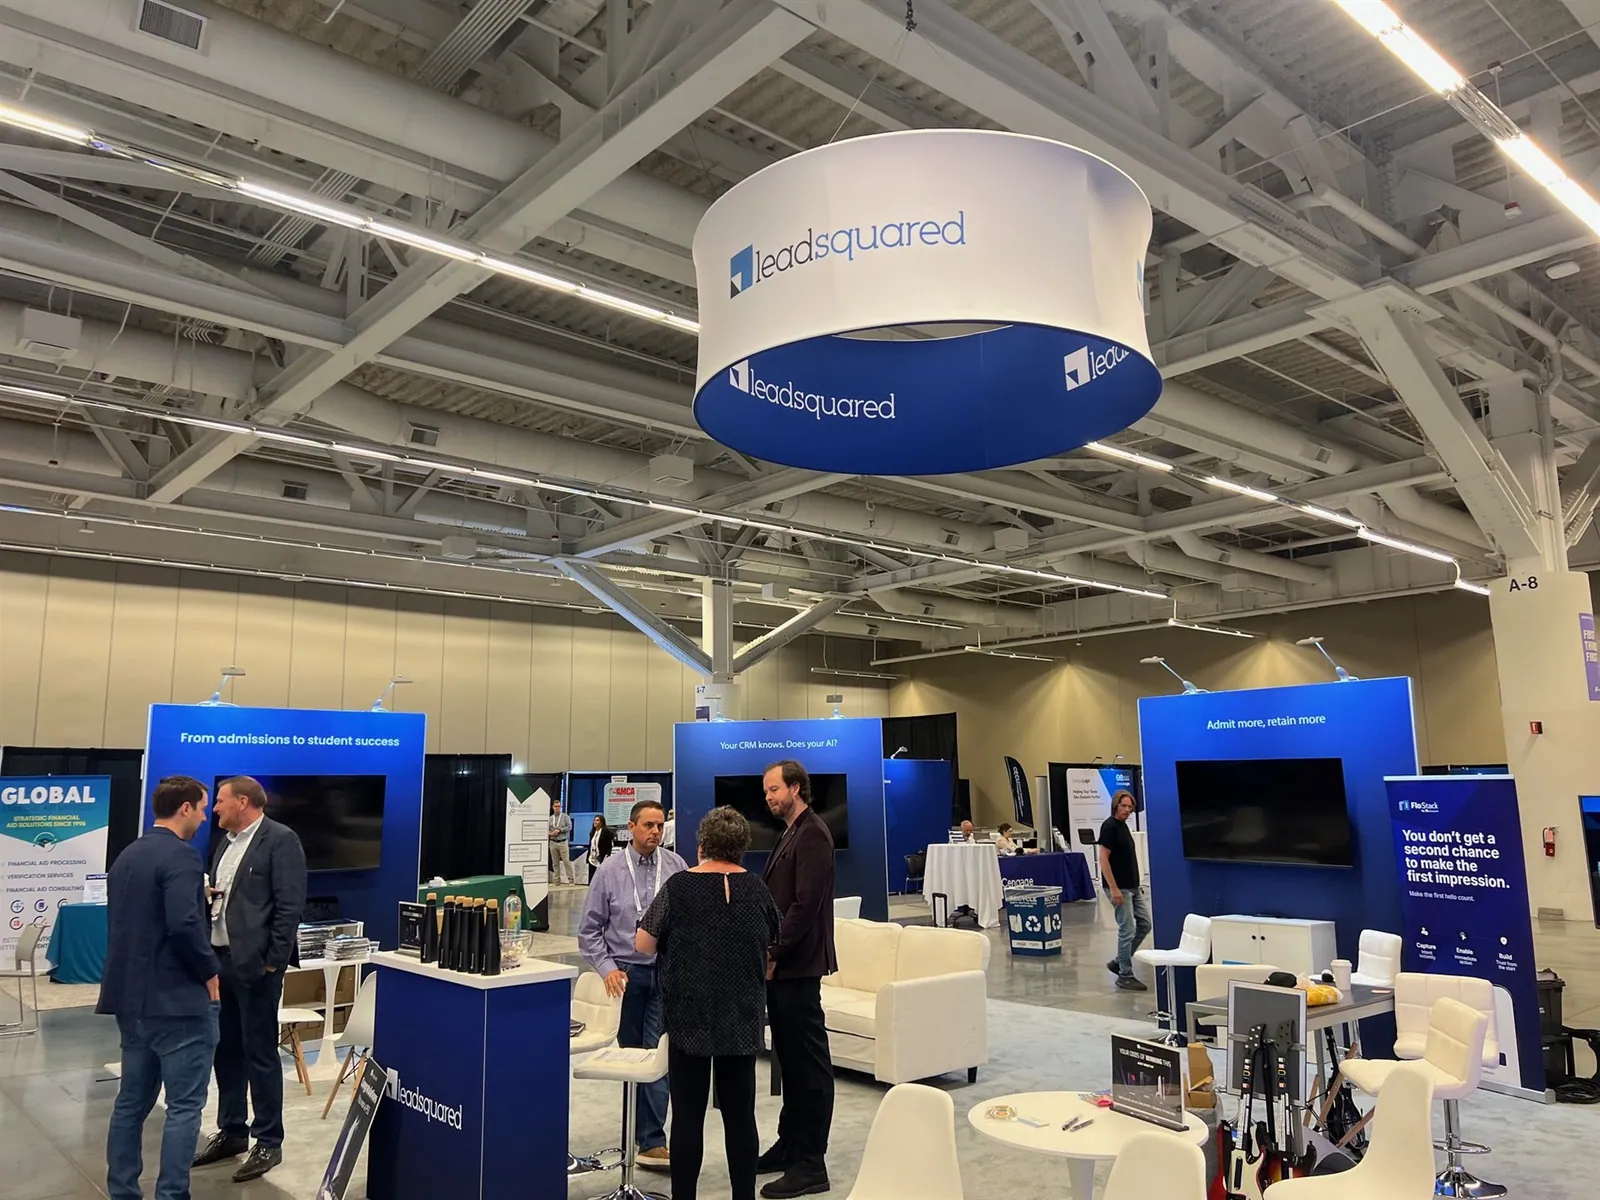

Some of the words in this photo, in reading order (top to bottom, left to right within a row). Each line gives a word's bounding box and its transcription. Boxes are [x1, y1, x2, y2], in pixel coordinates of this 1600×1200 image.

[756, 210, 966, 284] leadsquared
[750, 368, 896, 420] leadsquared
[1509, 576, 1538, 592] A-8
[1207, 719, 1236, 730] Admit
[1238, 719, 1266, 729] more,
[1267, 715, 1297, 727] retain
[1299, 715, 1326, 725] more
[180, 732, 215, 744] From
[218, 733, 290, 745] admissions
[293, 735, 305, 745] to
[307, 735, 353, 746] student
[355, 737, 400, 747] success
[720, 741, 737, 750] Your
[739, 741, 757, 749] CRM
[758, 740, 785, 749] knows.
[786, 739, 806, 748] Does
[807, 740, 824, 750] your
[825, 739, 838, 747] AI?
[1, 786, 96, 805] GLOBAL
[616, 787, 635, 796] AMCA
[1410, 801, 1438, 809] FloStack
[1402, 829, 1426, 842] You
[1428, 830, 1462, 843] don't
[1463, 832, 1485, 846] get
[1487, 835, 1496, 844] a
[1404, 844, 1449, 857] second
[1452, 845, 1500, 859] chance
[1405, 857, 1418, 868] to
[1420, 858, 1454, 871] make
[1456, 859, 1478, 872] the
[1407, 870, 1434, 883] first
[1435, 871, 1510, 889] impression.
[1416, 942, 1436, 950] Capture
[1456, 947, 1473, 955] Enable
[397, 1078, 463, 1130] leadsquared
